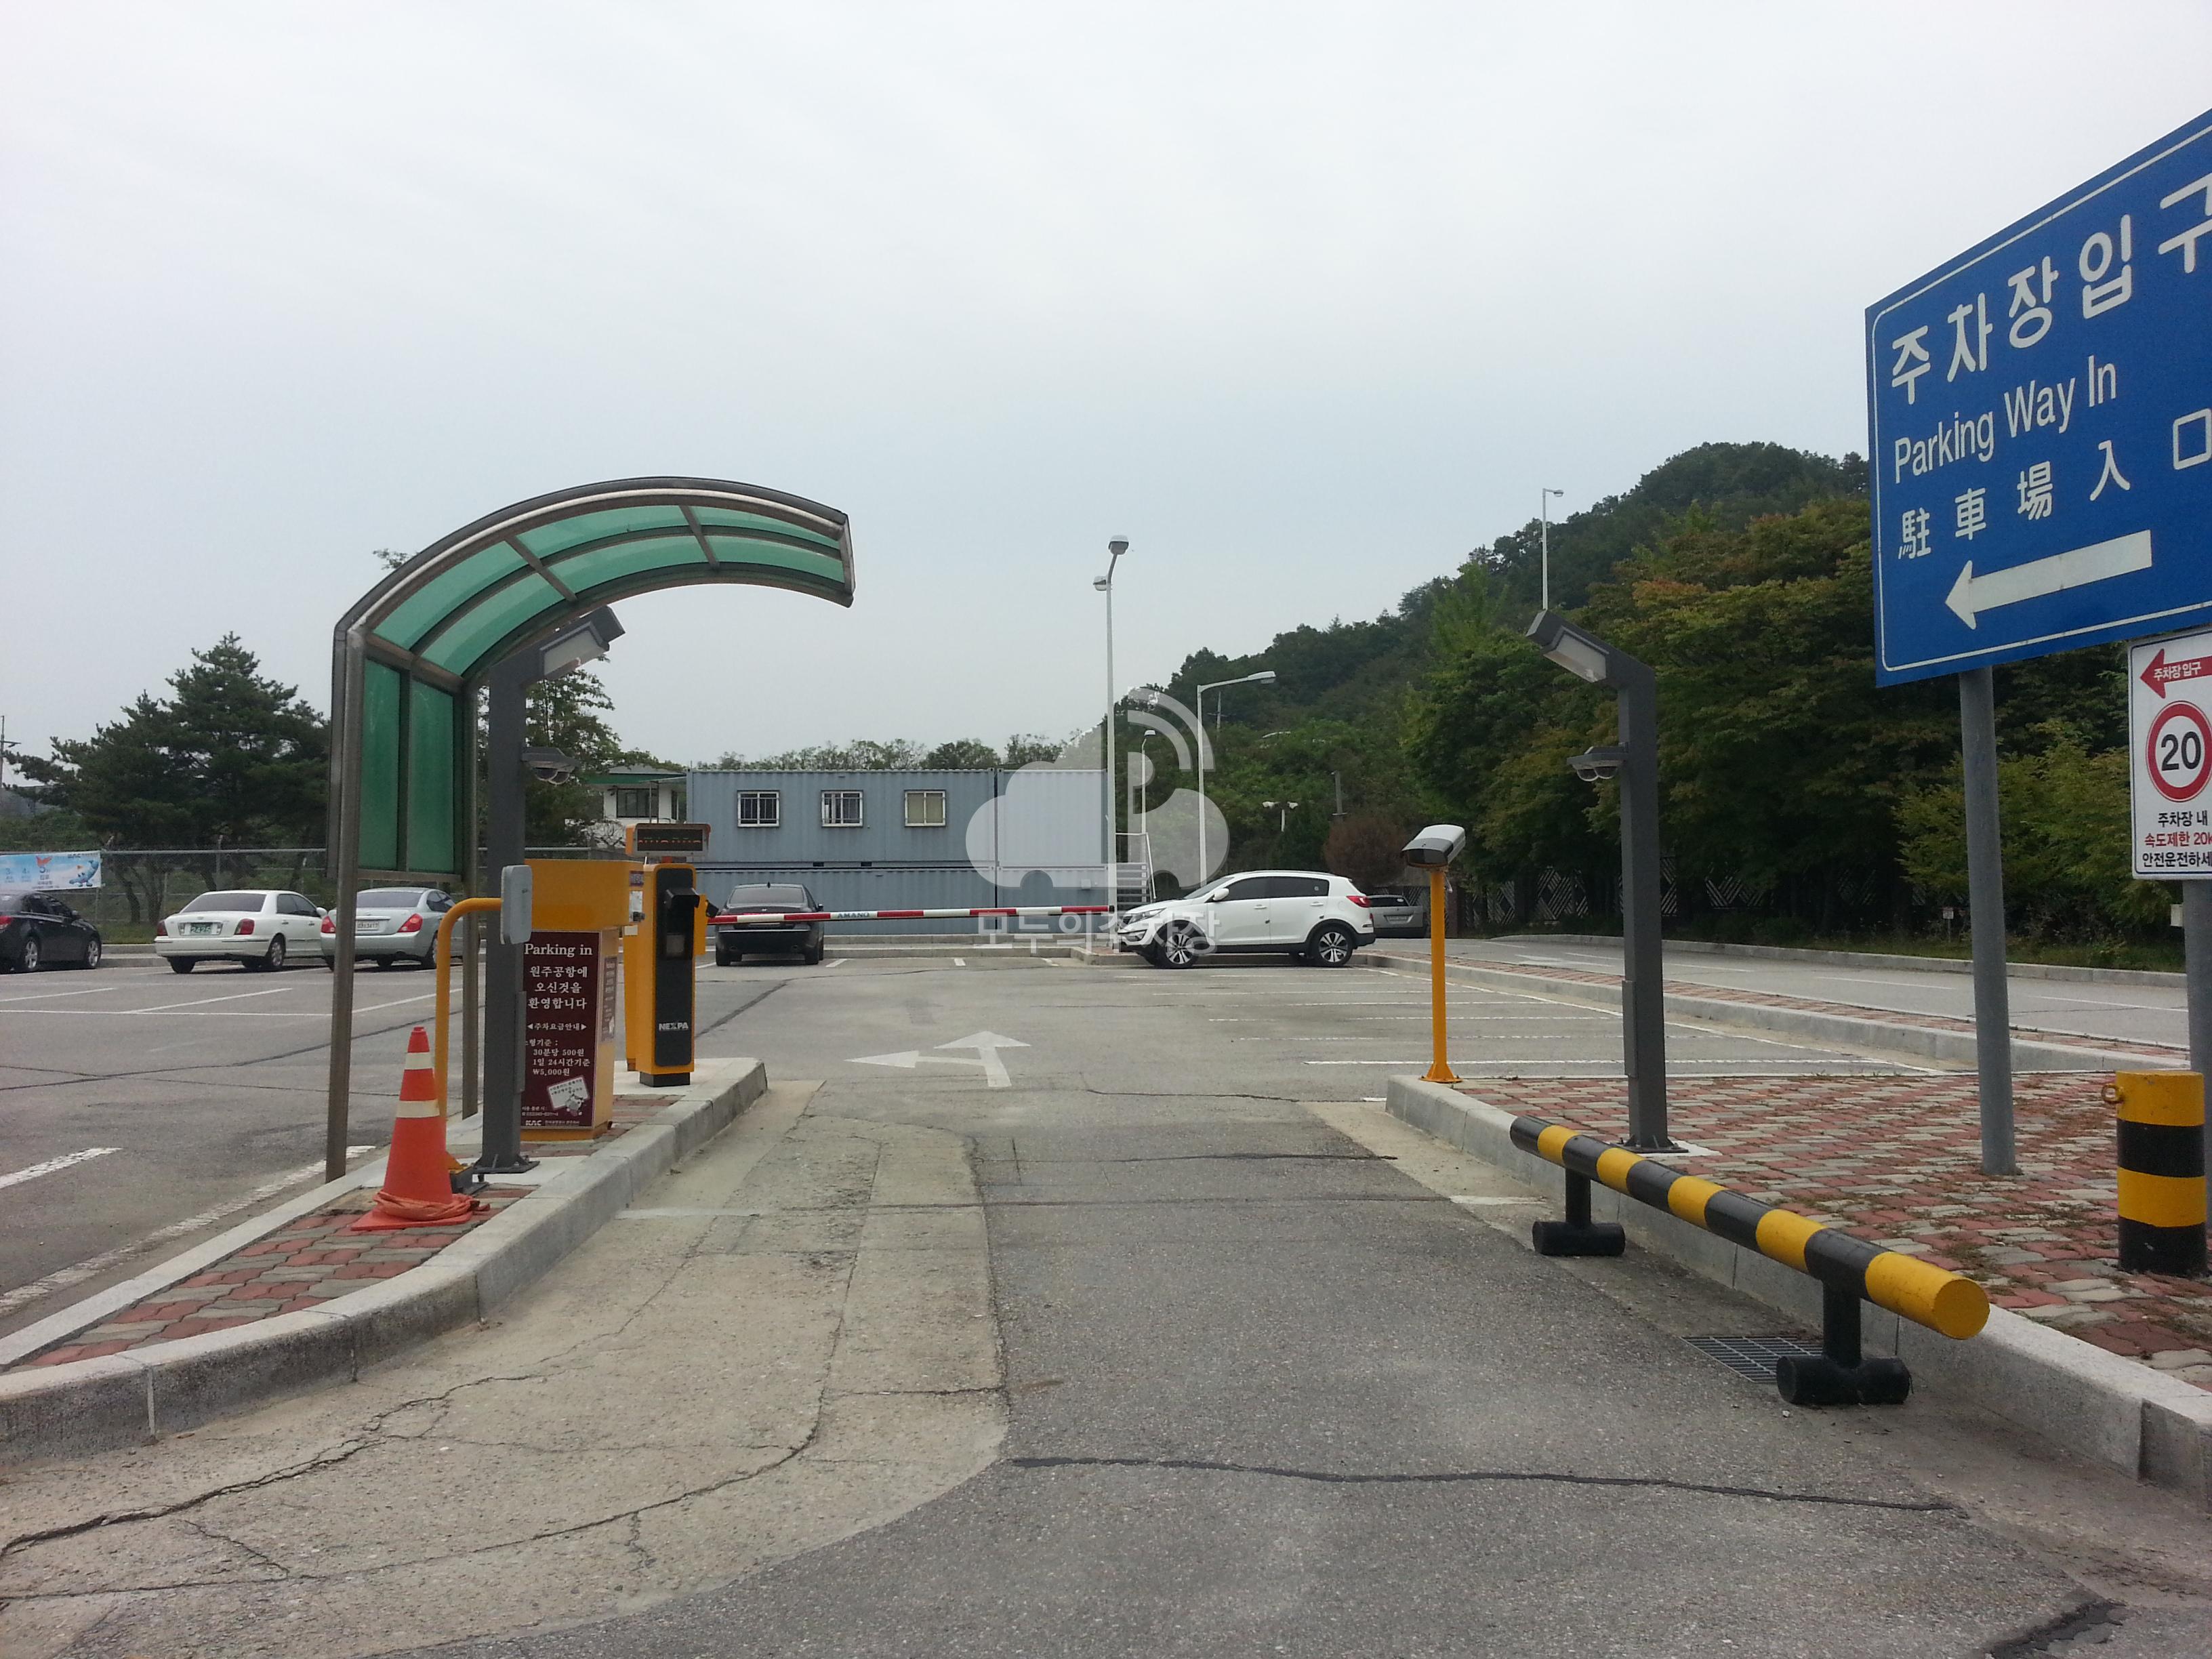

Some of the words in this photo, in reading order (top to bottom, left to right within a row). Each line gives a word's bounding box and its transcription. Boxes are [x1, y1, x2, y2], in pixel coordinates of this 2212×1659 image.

[1895, 411, 1995, 484] Parking
[2004, 377, 2076, 437] Way
[2088, 354, 2116, 407] In
[2154, 665, 2182, 681] 주차장
[2182, 661, 2202, 676] 입구
[2160, 731, 2202, 771] 20
[2158, 811, 2193, 827] 주차장
[2196, 810, 2208, 826] 내
[2144, 831, 2190, 848] 속도제한
[524, 943, 576, 958] Parking
[579, 944, 593, 956] in
[530, 966, 588, 978] 원주공항에
[535, 981, 582, 994] 오신것을
[528, 997, 587, 1010] 환영합니다
[534, 1023, 579, 1031] 주차요금안내
[659, 1022, 689, 1031] NEXPA
[533, 1048, 559, 1057] 30분당
[562, 1048, 585, 1057] 500원
[533, 1058, 545, 1067] 1일
[548, 1058, 590, 1067] 24시간기준
